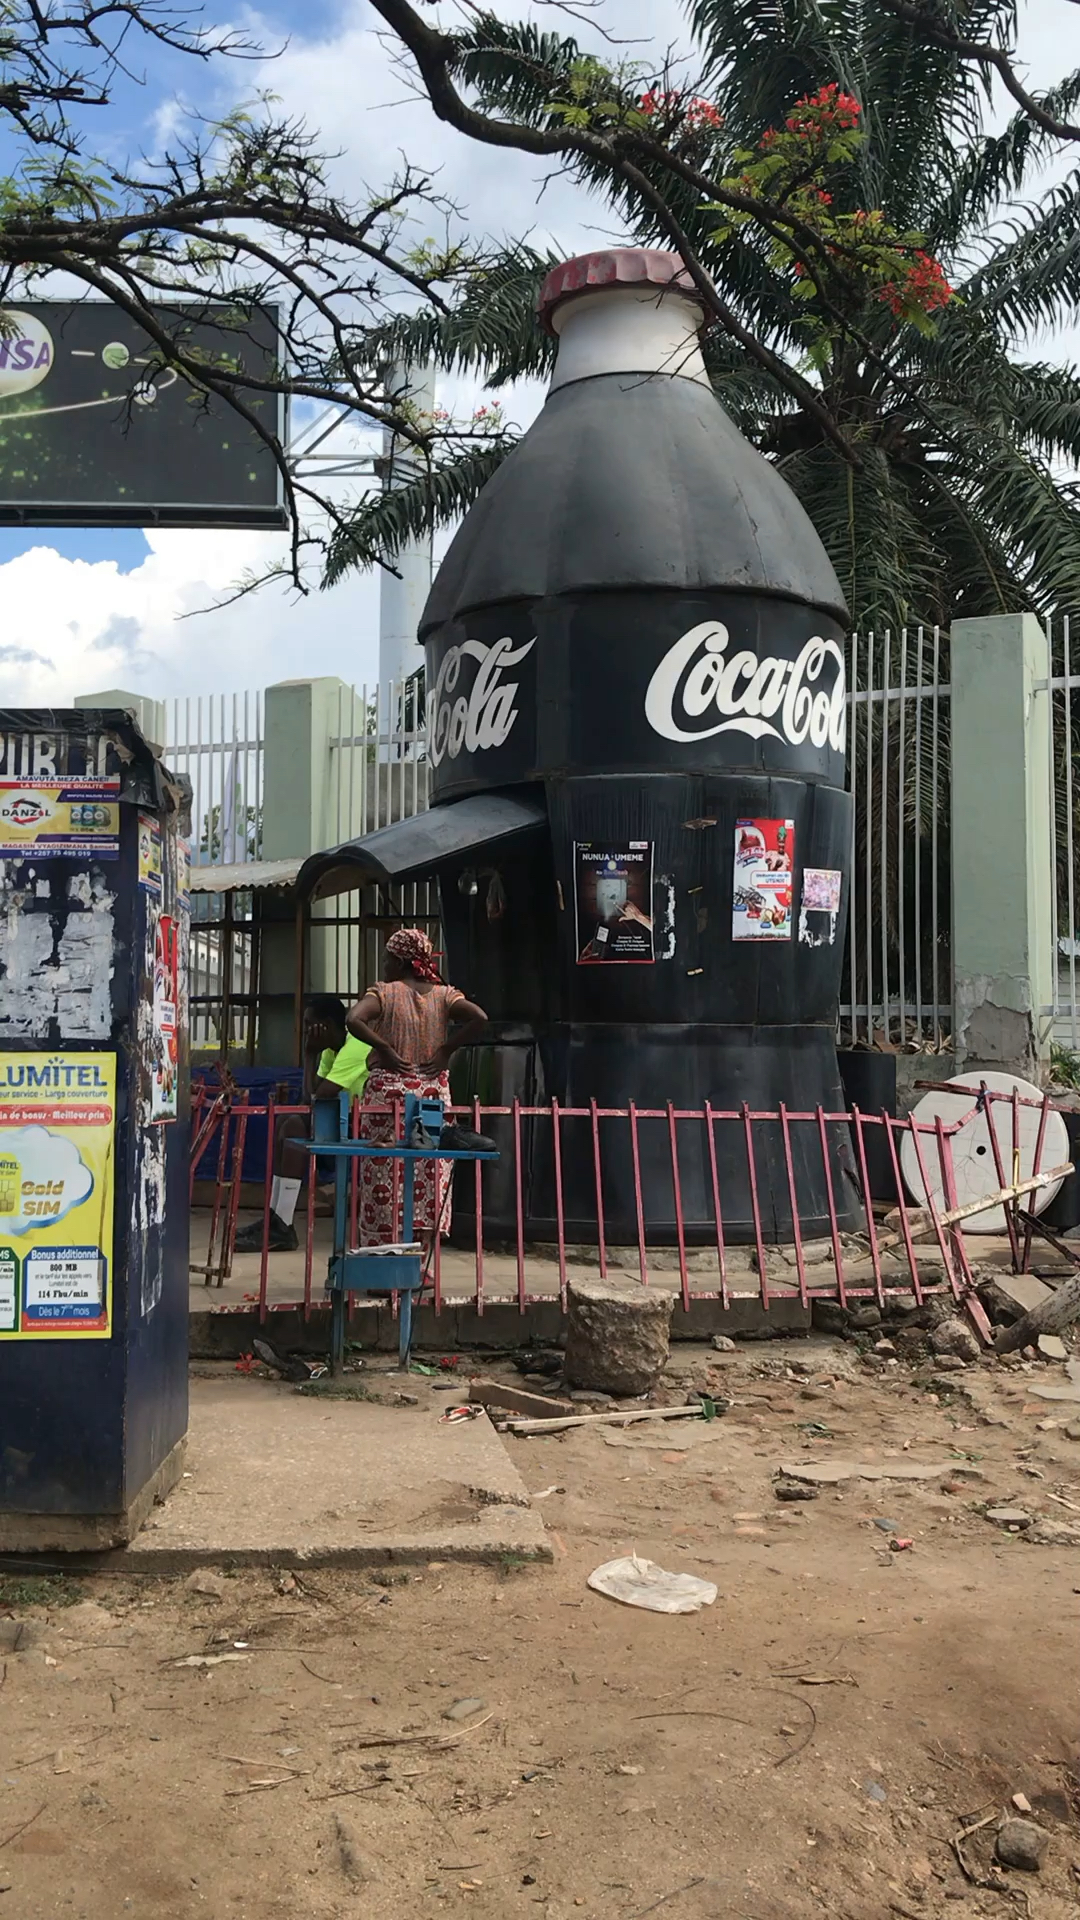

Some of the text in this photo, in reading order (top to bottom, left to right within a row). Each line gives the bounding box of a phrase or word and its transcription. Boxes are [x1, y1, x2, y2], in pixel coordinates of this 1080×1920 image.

[0, 339, 50, 371] ISA
[582, 853, 644, 861] NUNUA UMEME
[0, 1065, 108, 1087] UMITEL
[12, 1089, 38, 1098] service
[45, 1090, 66, 1099] Large
[67, 1089, 108, 1098] couverture
[9, 1111, 20, 1119] de
[52, 1110, 87, 1119] Meilleur
[88, 1111, 105, 1121] prix
[21, 1180, 65, 1196] Gold
[23, 1200, 61, 1216] SIM
[31, 1249, 98, 1260] Bonus additionnel
[65, 1263, 77, 1271] MB
[38, 1289, 88, 1298] 114 Fbu/min
[53, 1306, 60, 1316] le
[73, 1307, 90, 1316] mois
